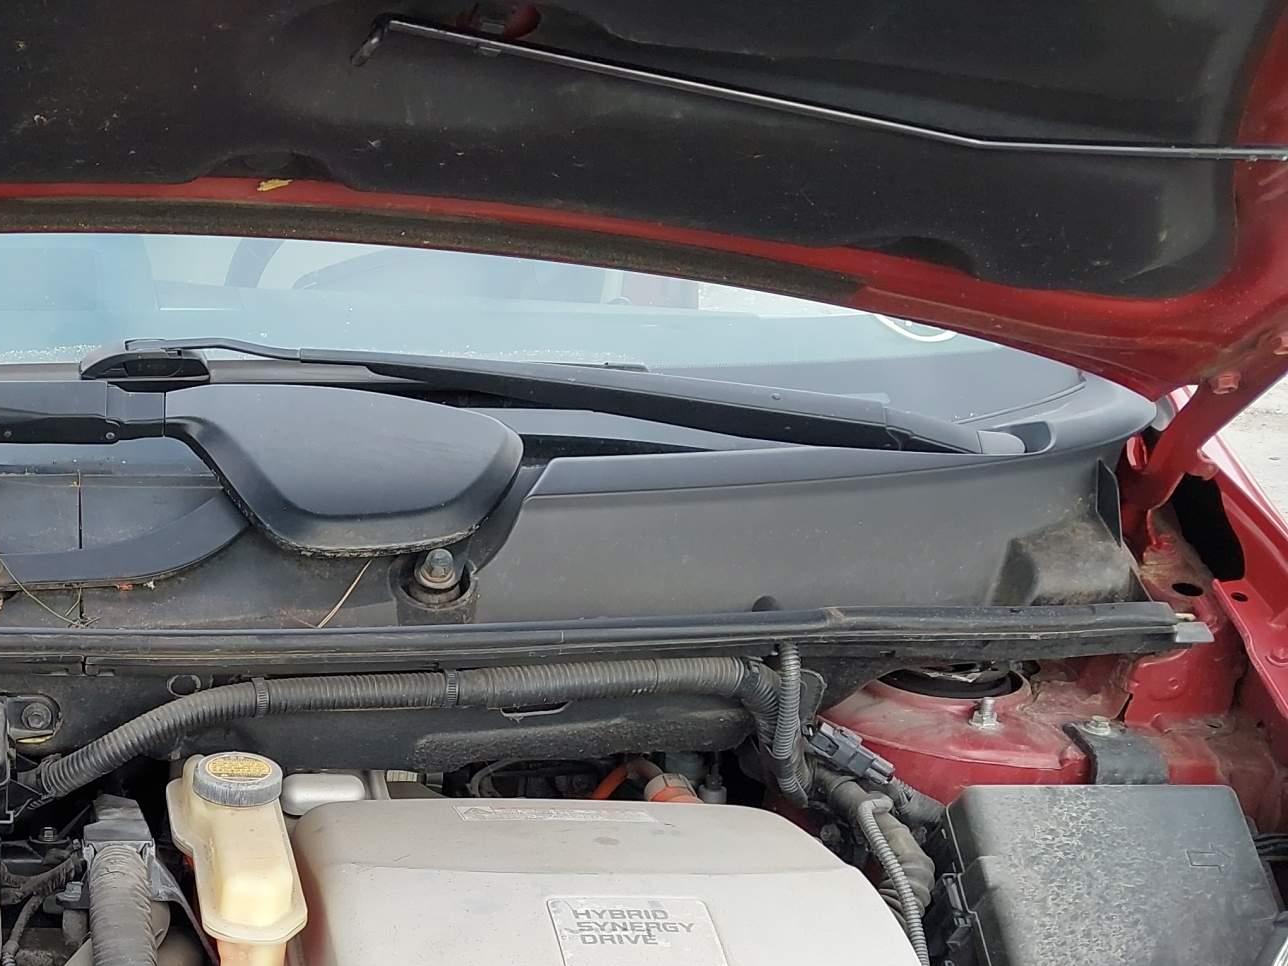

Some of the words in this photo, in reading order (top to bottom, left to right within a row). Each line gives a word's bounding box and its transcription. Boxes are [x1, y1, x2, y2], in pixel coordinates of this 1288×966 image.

[572, 909, 669, 920] HYBRID
[576, 921, 694, 933] SYNERGY
[580, 934, 659, 945] DRIVE
